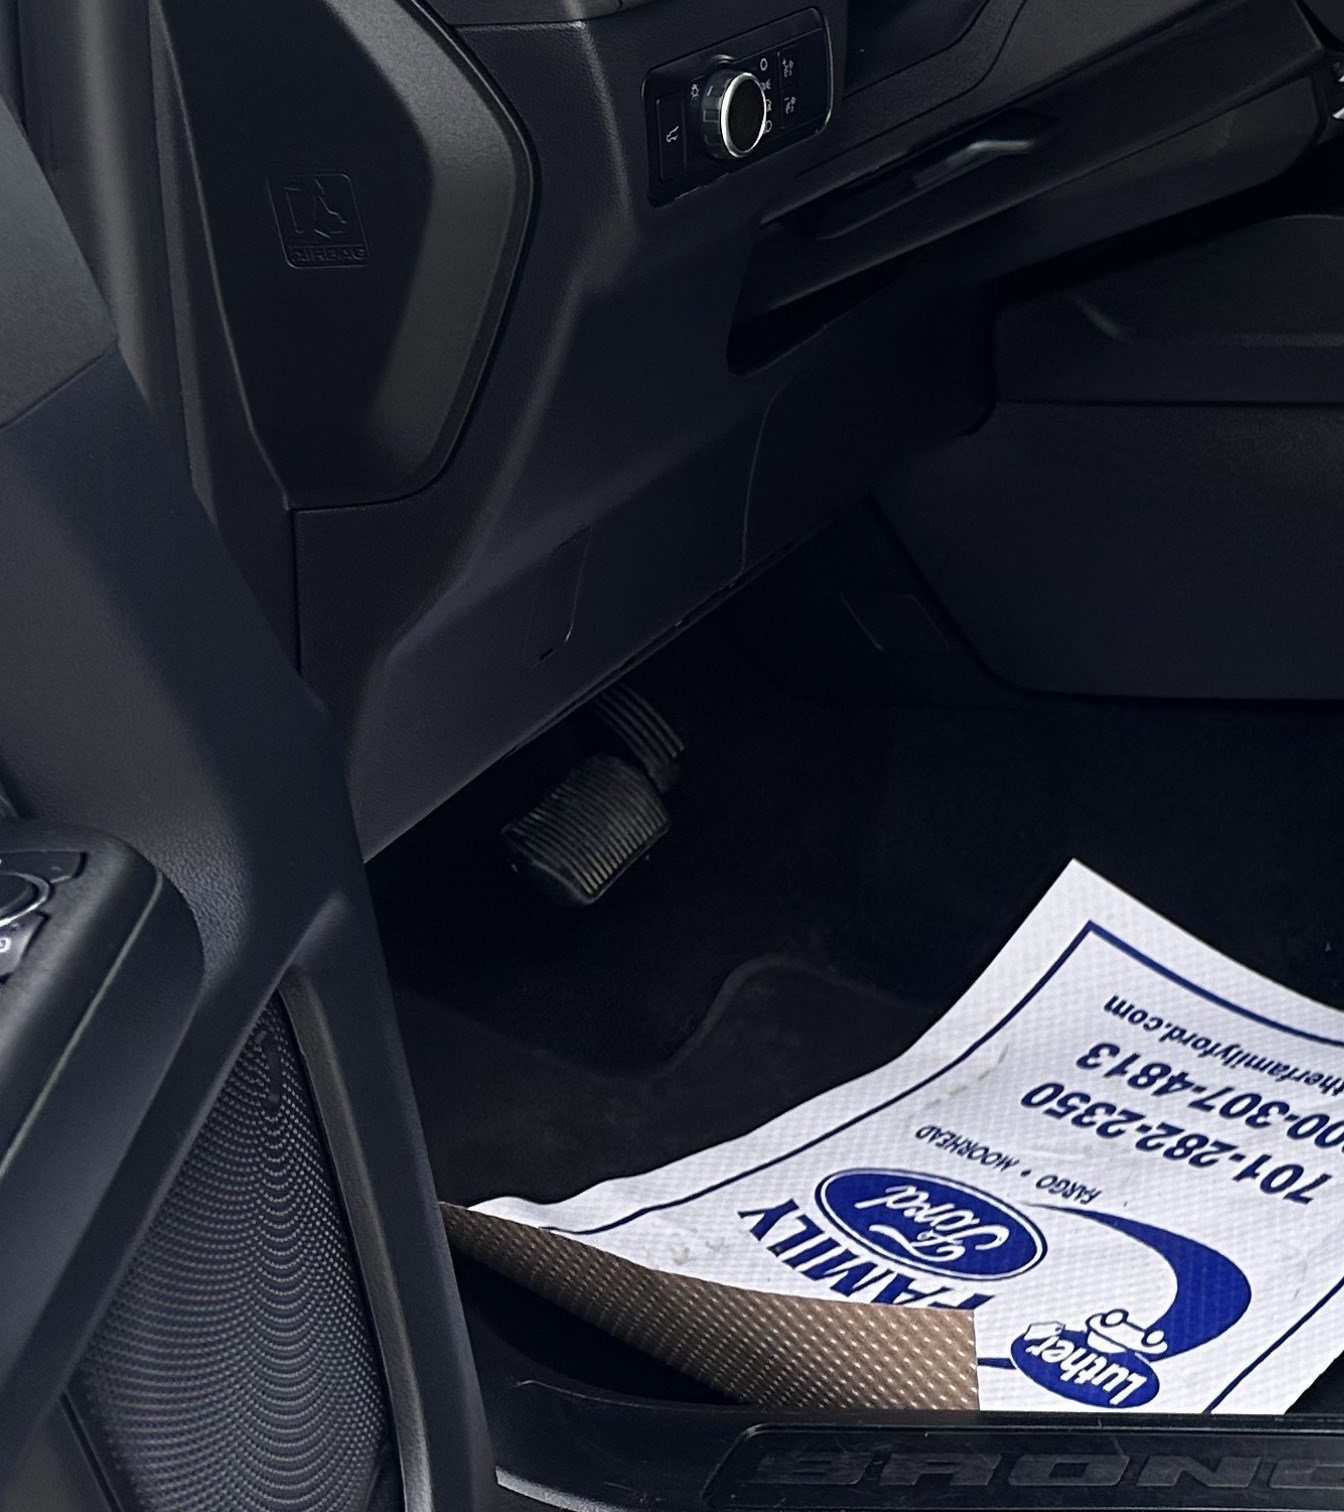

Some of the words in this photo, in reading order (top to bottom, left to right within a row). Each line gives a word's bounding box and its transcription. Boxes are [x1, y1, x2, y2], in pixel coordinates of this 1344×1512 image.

[915, 1124, 1020, 1173] MOORHEAD
[1020, 1082, 1334, 1205] 701-282-2350
[856, 1184, 1012, 1263] Ford
[1035, 1174, 1102, 1205] FARGO
[1025, 1336, 1148, 1405] Luther
